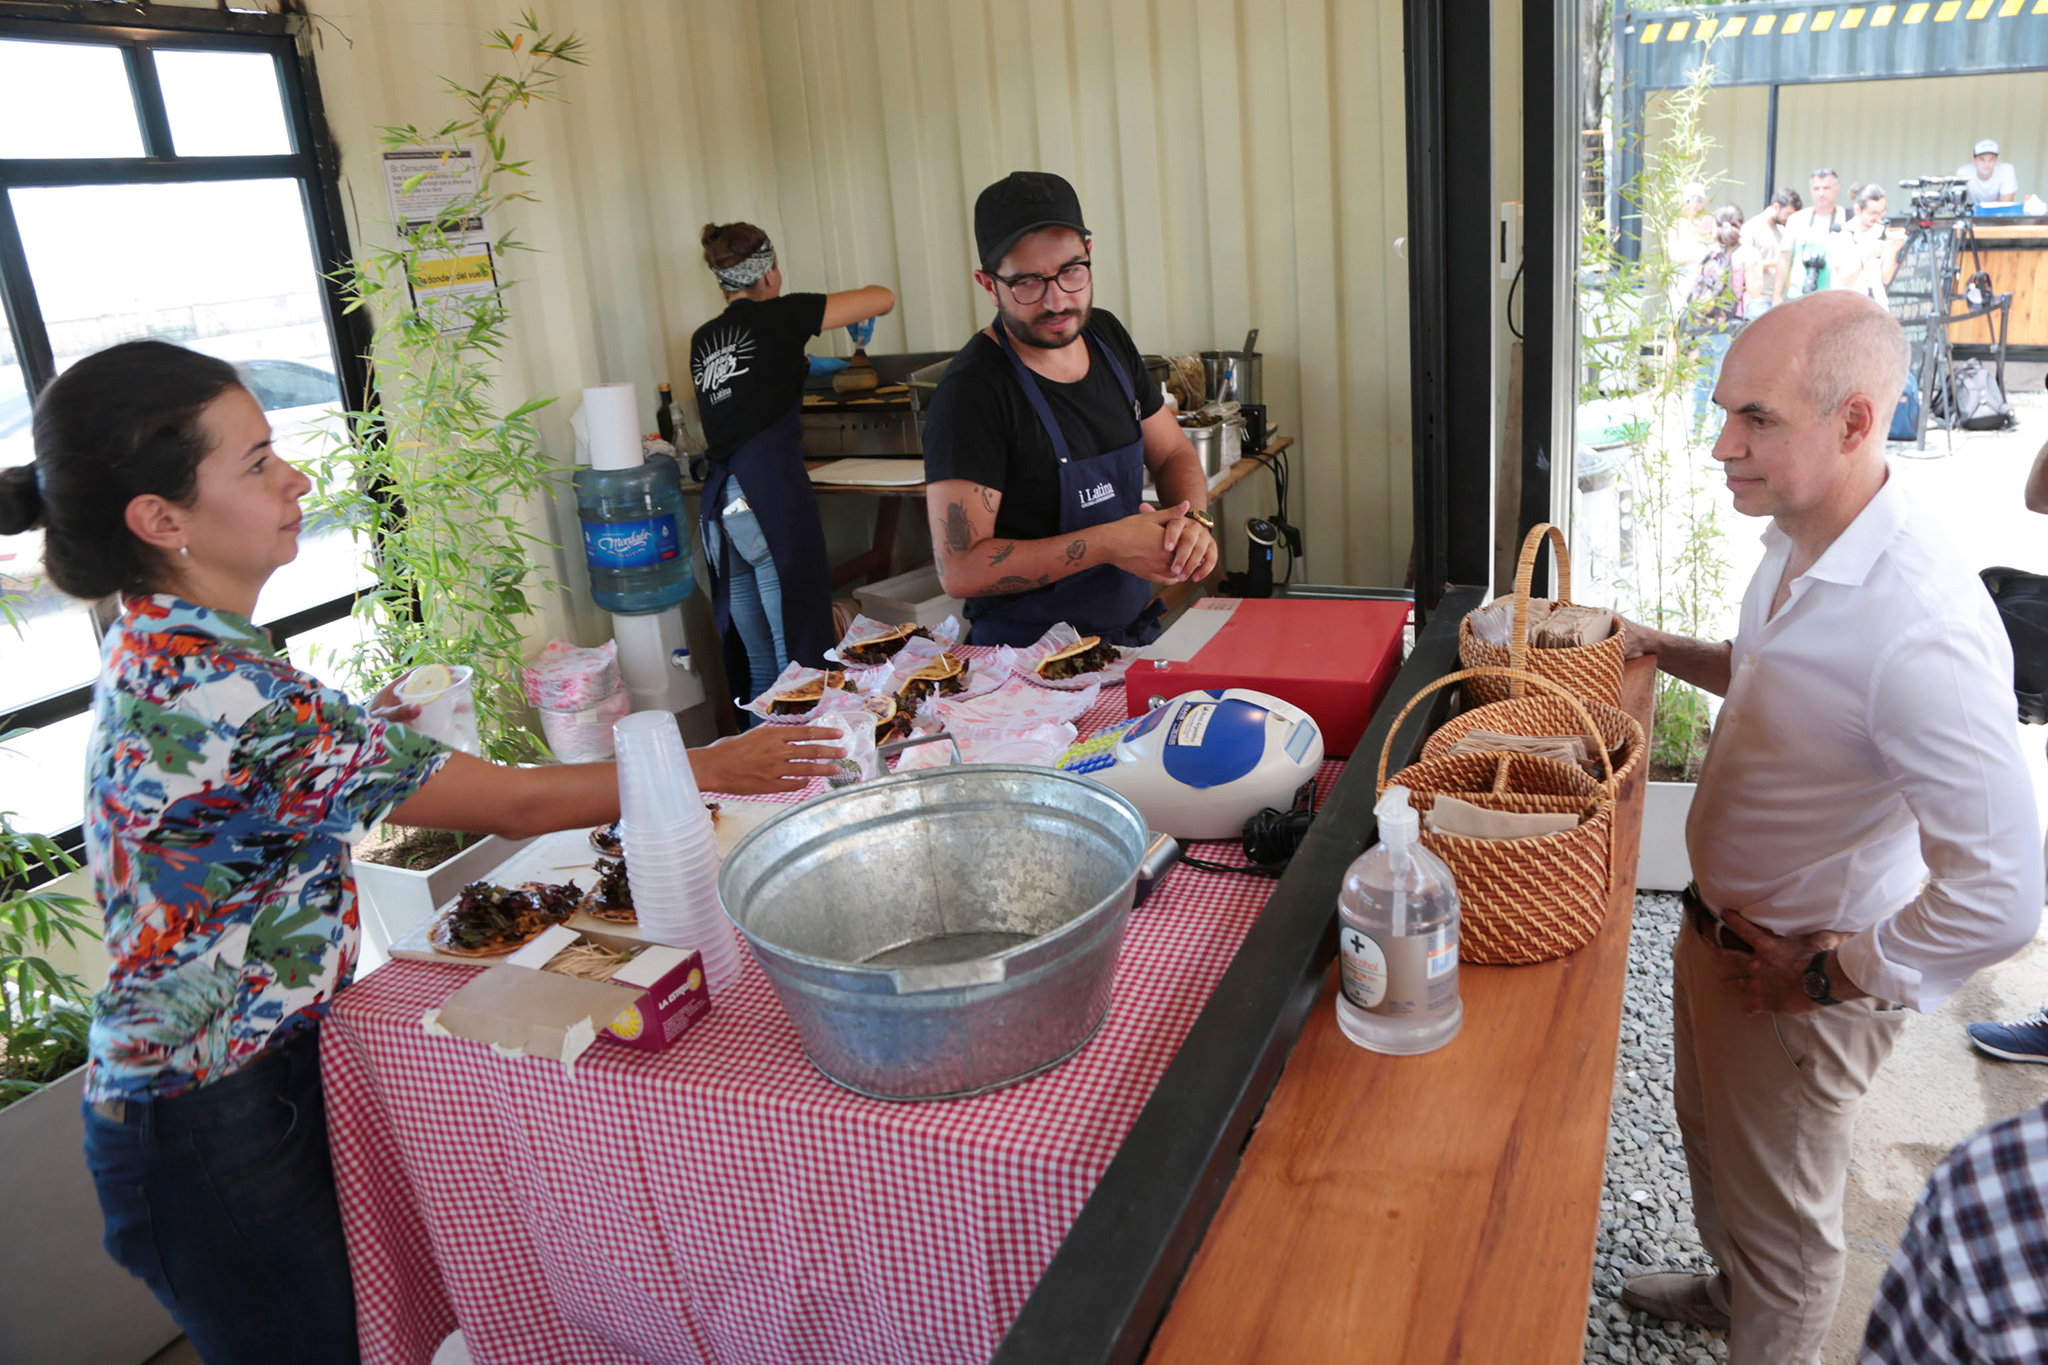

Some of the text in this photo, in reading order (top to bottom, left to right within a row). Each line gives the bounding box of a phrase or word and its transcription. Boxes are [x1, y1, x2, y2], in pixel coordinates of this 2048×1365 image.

[418, 273, 453, 285] Redonde
[468, 269, 489, 278] vueo
[1085, 482, 1115, 501] Latina
